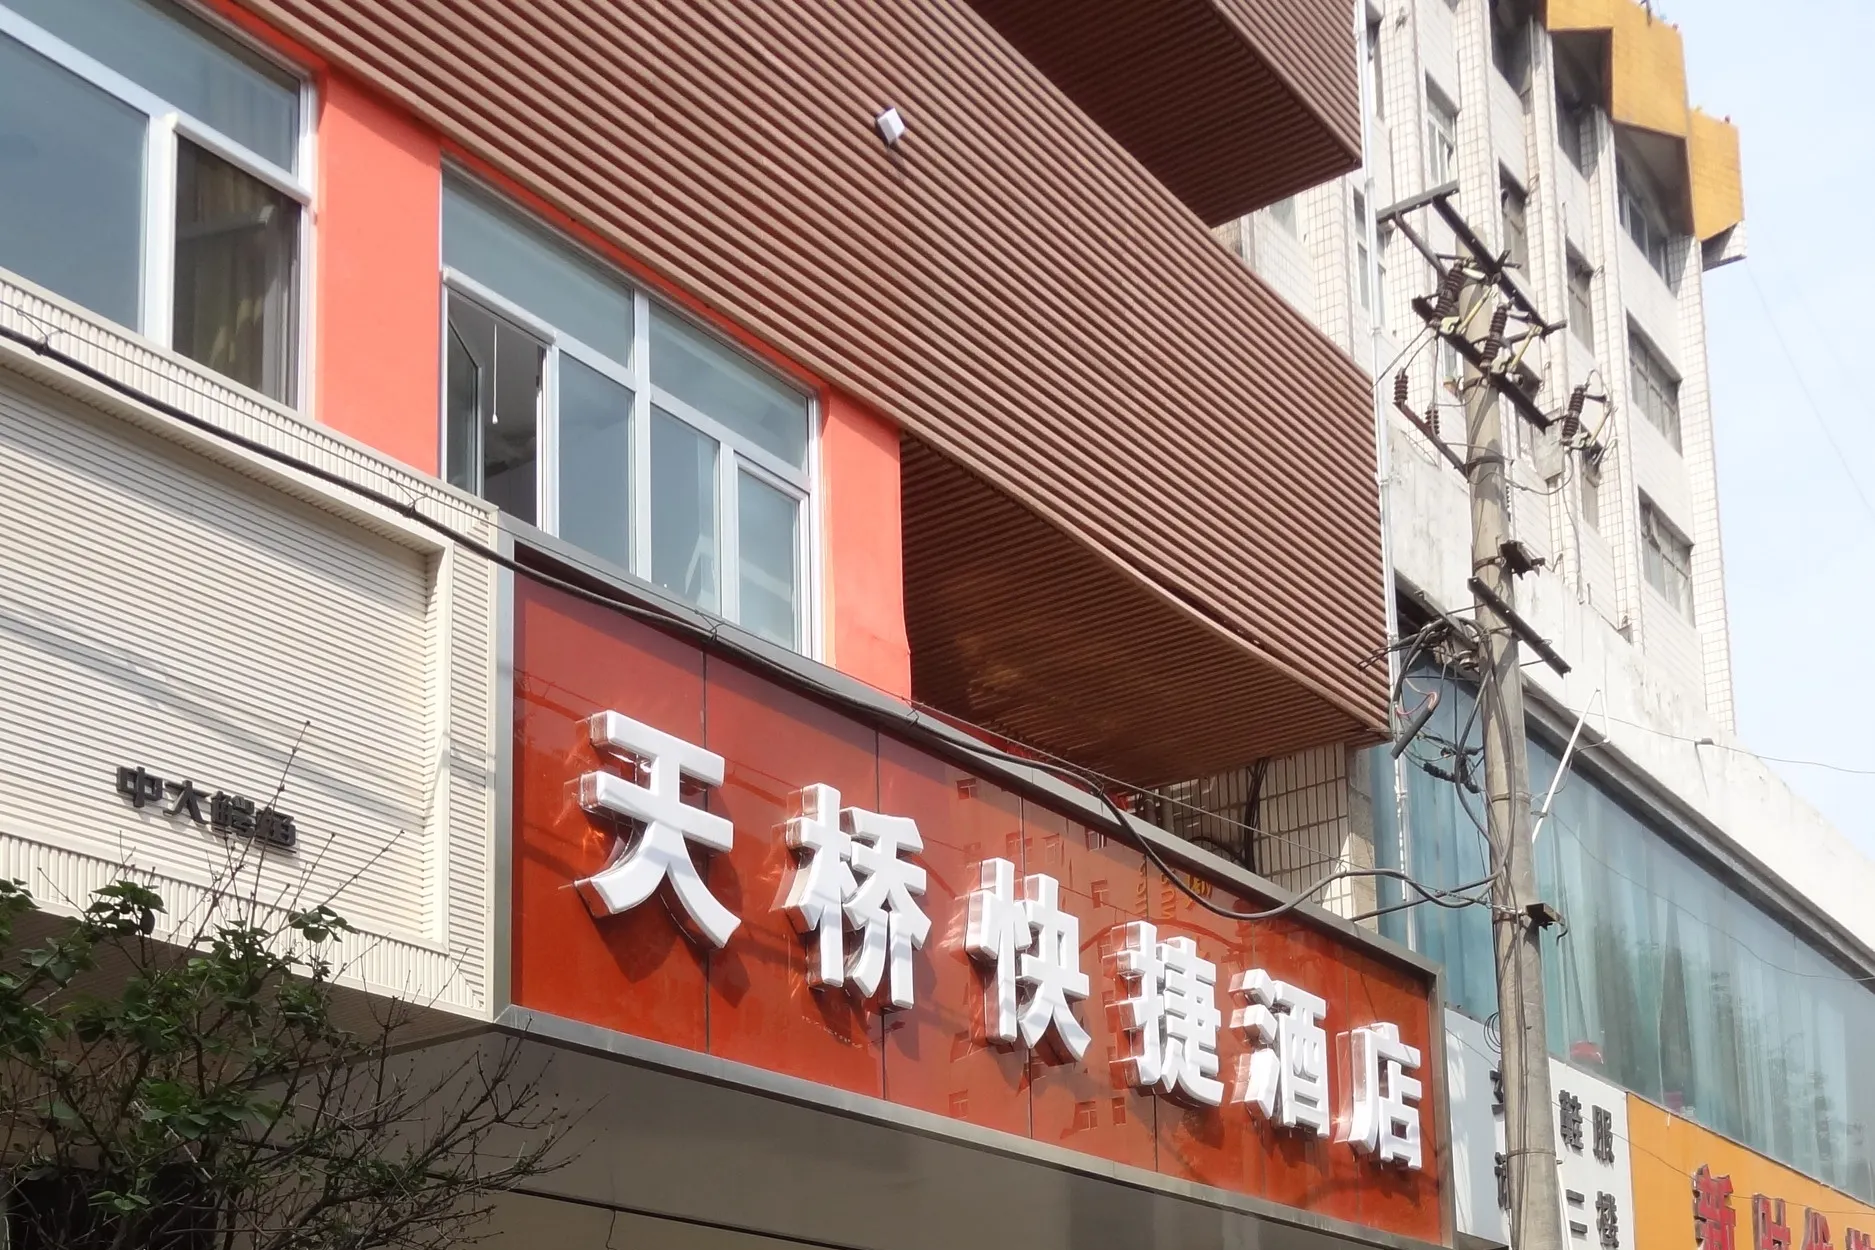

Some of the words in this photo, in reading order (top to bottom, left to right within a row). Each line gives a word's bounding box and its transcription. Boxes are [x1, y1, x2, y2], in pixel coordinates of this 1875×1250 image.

[575, 709, 1422, 1170] 天桥快捷酒店
